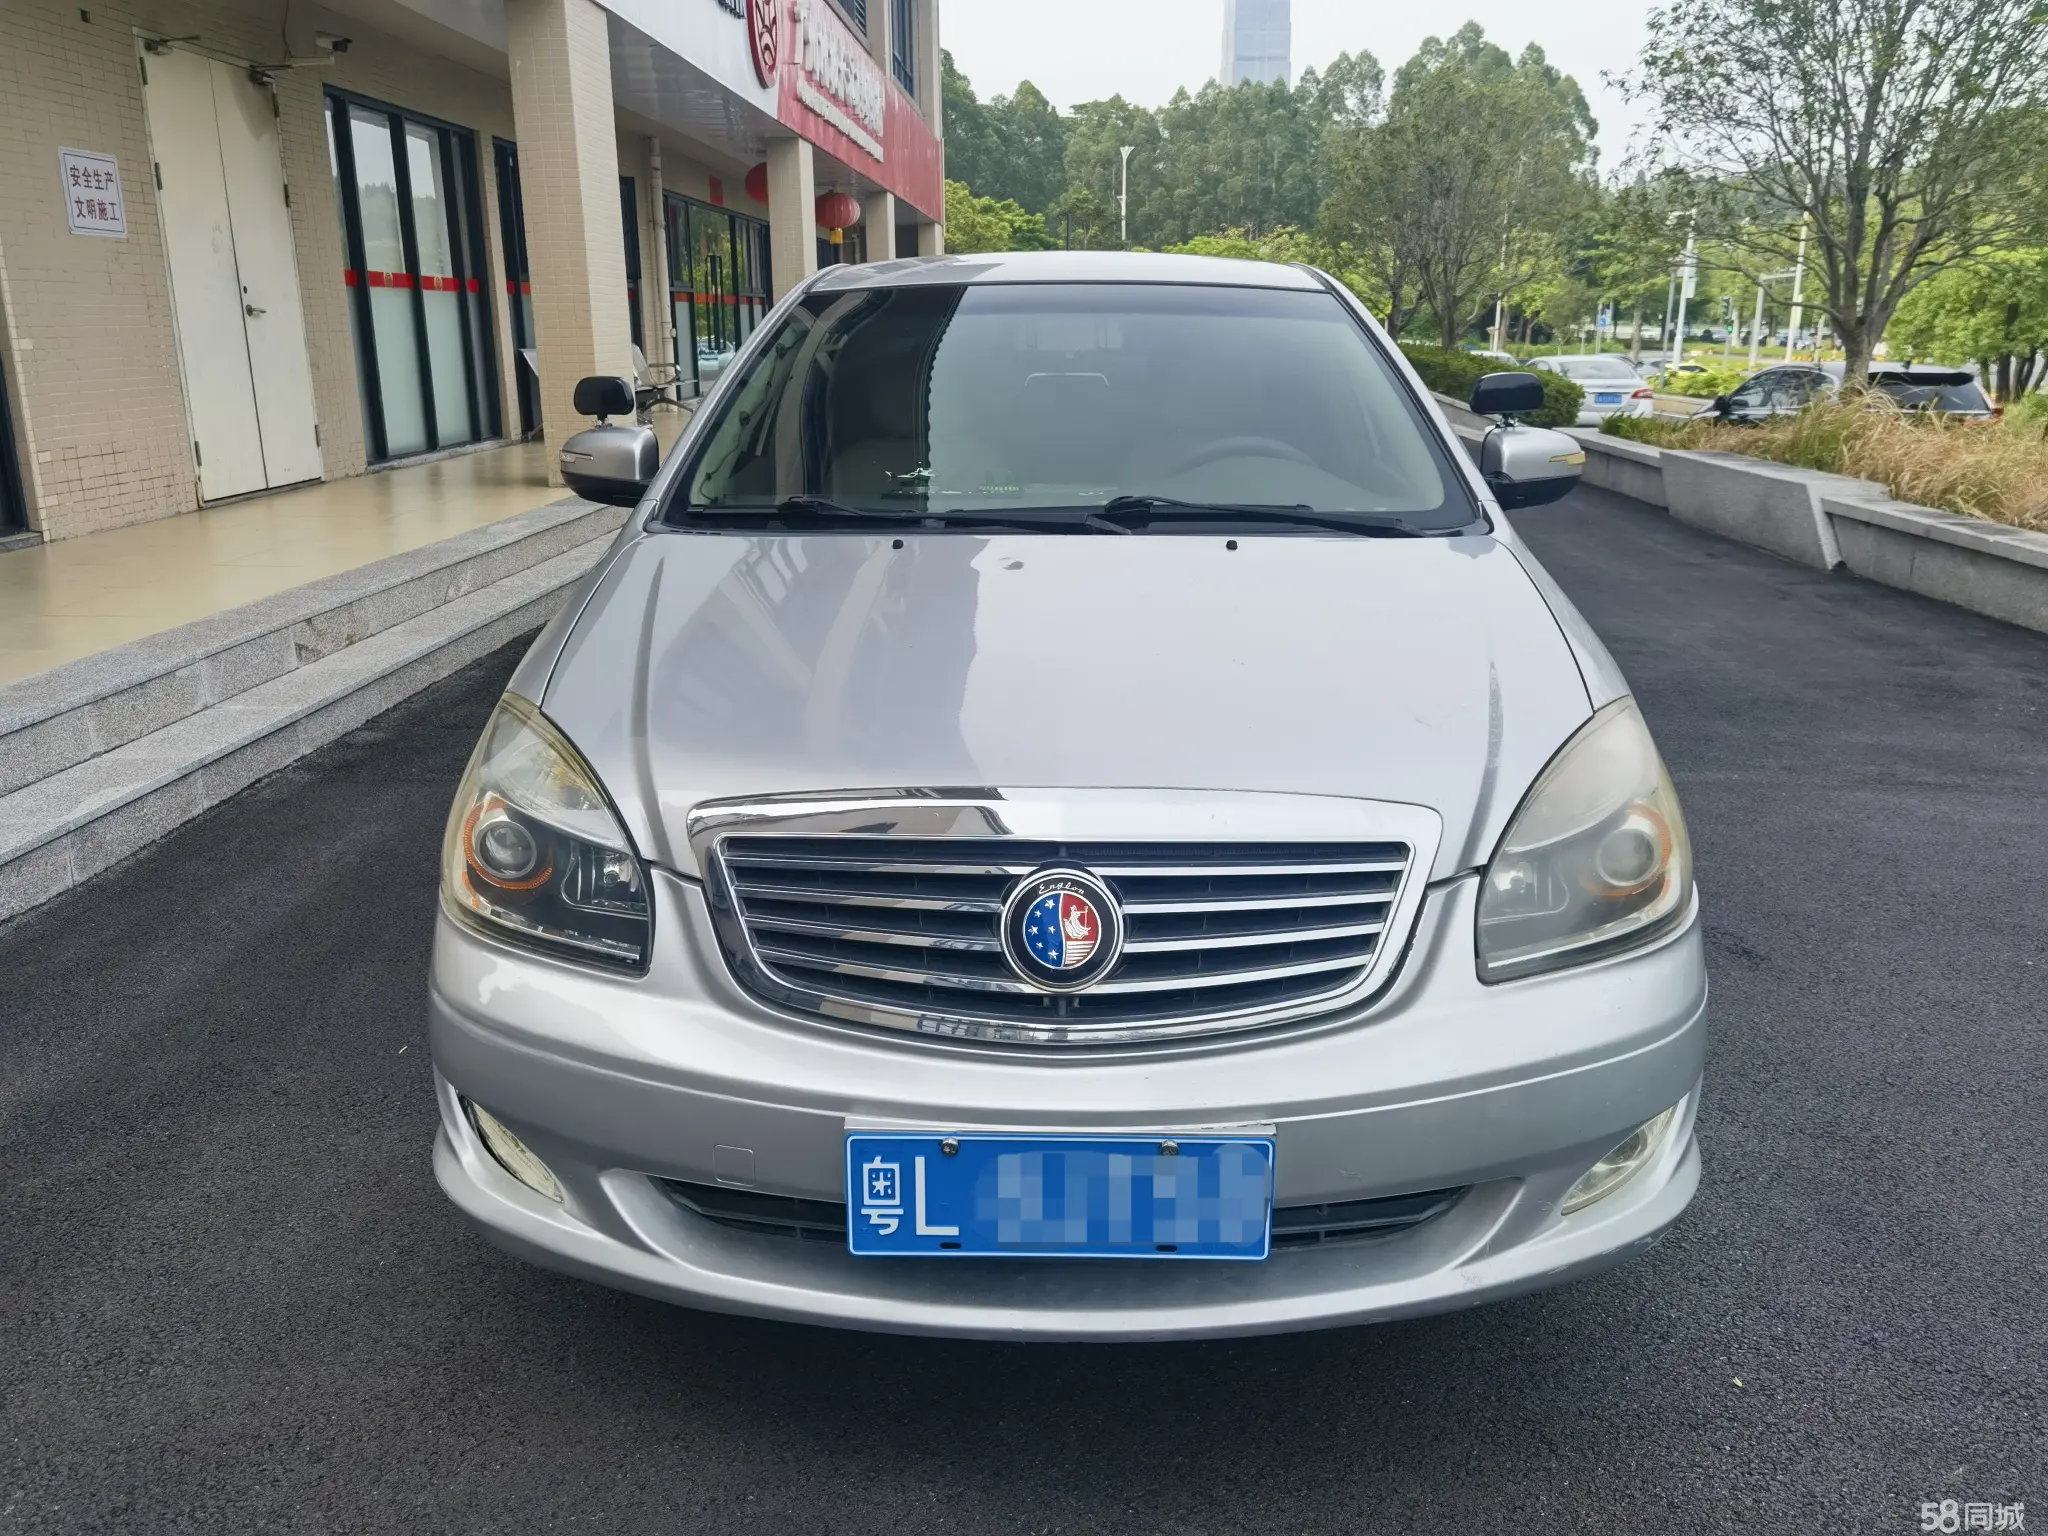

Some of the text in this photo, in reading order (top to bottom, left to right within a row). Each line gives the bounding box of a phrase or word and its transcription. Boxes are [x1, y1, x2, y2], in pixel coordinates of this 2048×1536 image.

[70, 164, 114, 191] 安全生产
[74, 196, 120, 221] 文明施工
[1038, 882, 1085, 895] Englon
